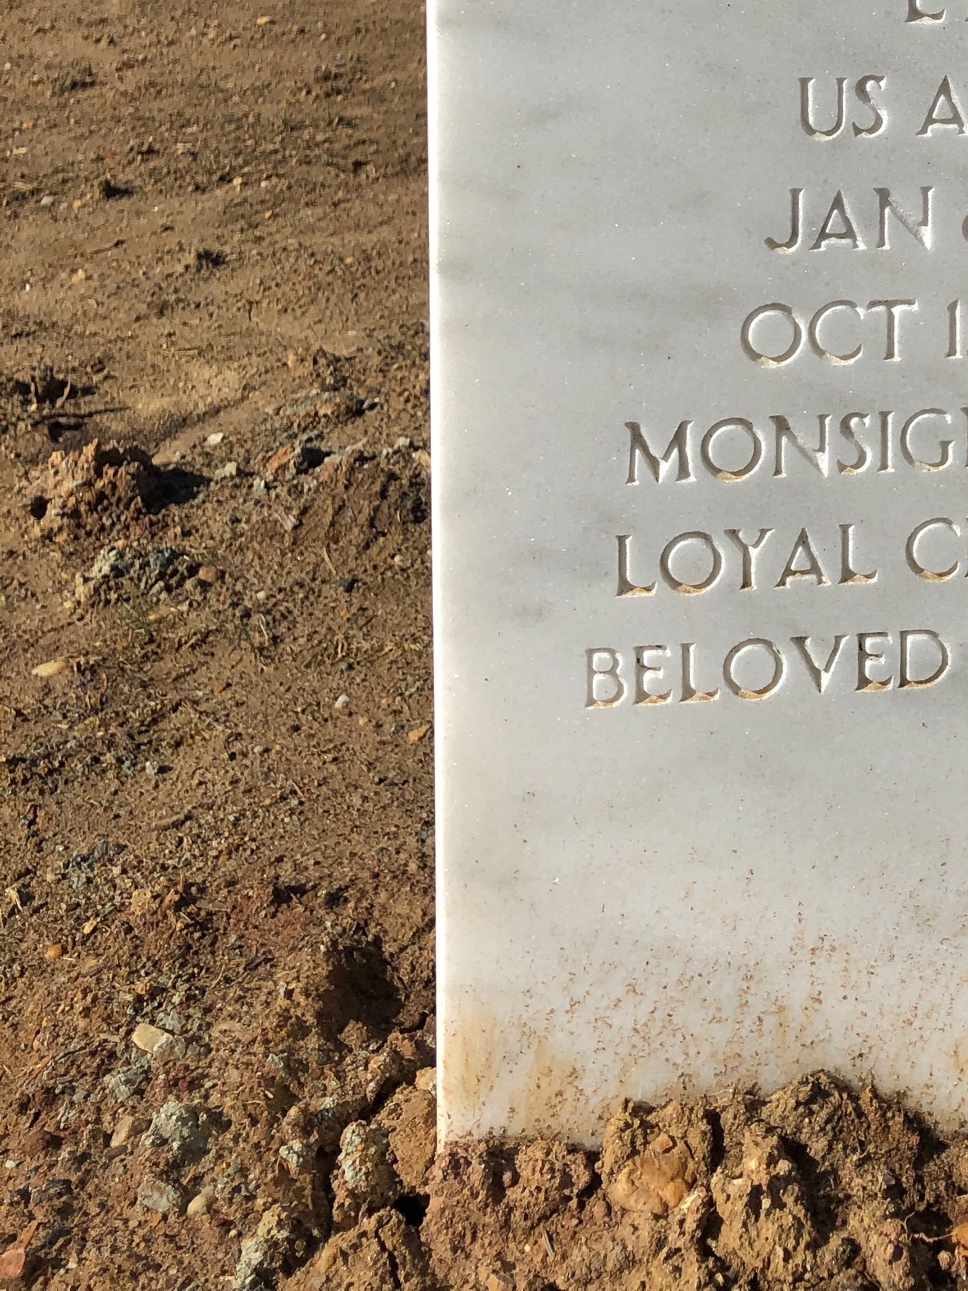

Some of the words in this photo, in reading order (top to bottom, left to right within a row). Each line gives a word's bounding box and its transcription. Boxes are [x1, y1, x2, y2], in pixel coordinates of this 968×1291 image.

[798, 73, 887, 141] US
[764, 185, 934, 254] JAN
[741, 299, 919, 365] OCT
[614, 525, 879, 596] LOYAL
[584, 628, 950, 708] BELOVED
